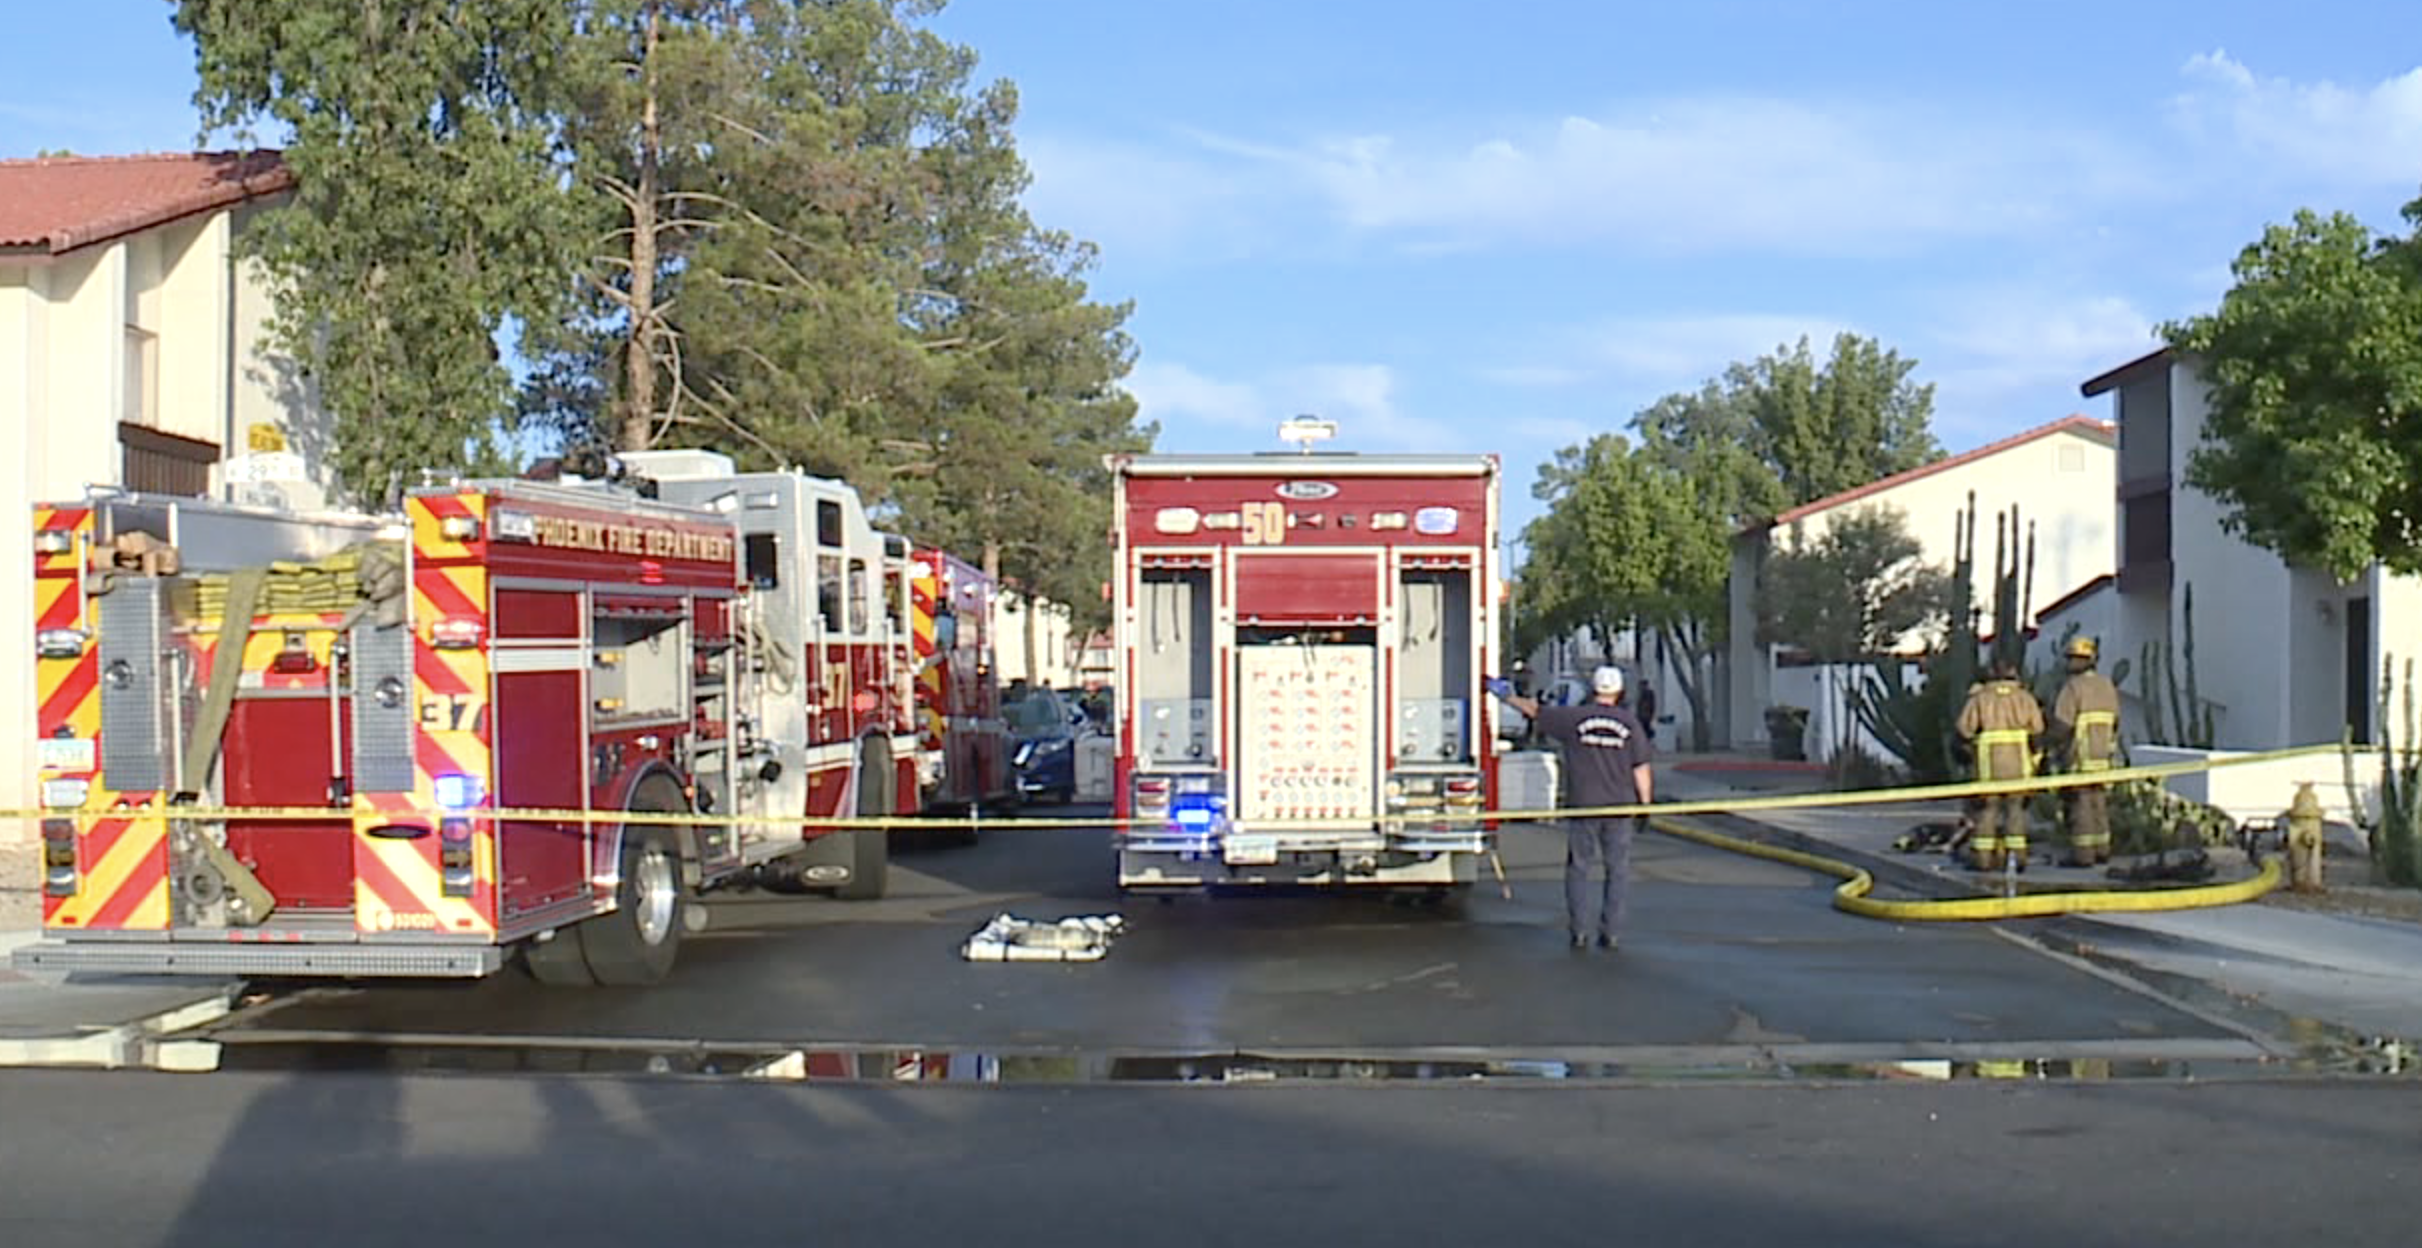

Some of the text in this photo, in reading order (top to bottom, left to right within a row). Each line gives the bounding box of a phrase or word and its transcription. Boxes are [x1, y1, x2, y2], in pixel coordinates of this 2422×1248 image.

[532, 514, 732, 562] PHOENIX FIRE DEPARTMENT
[1241, 502, 1285, 545] 50
[420, 693, 487, 731] 37
